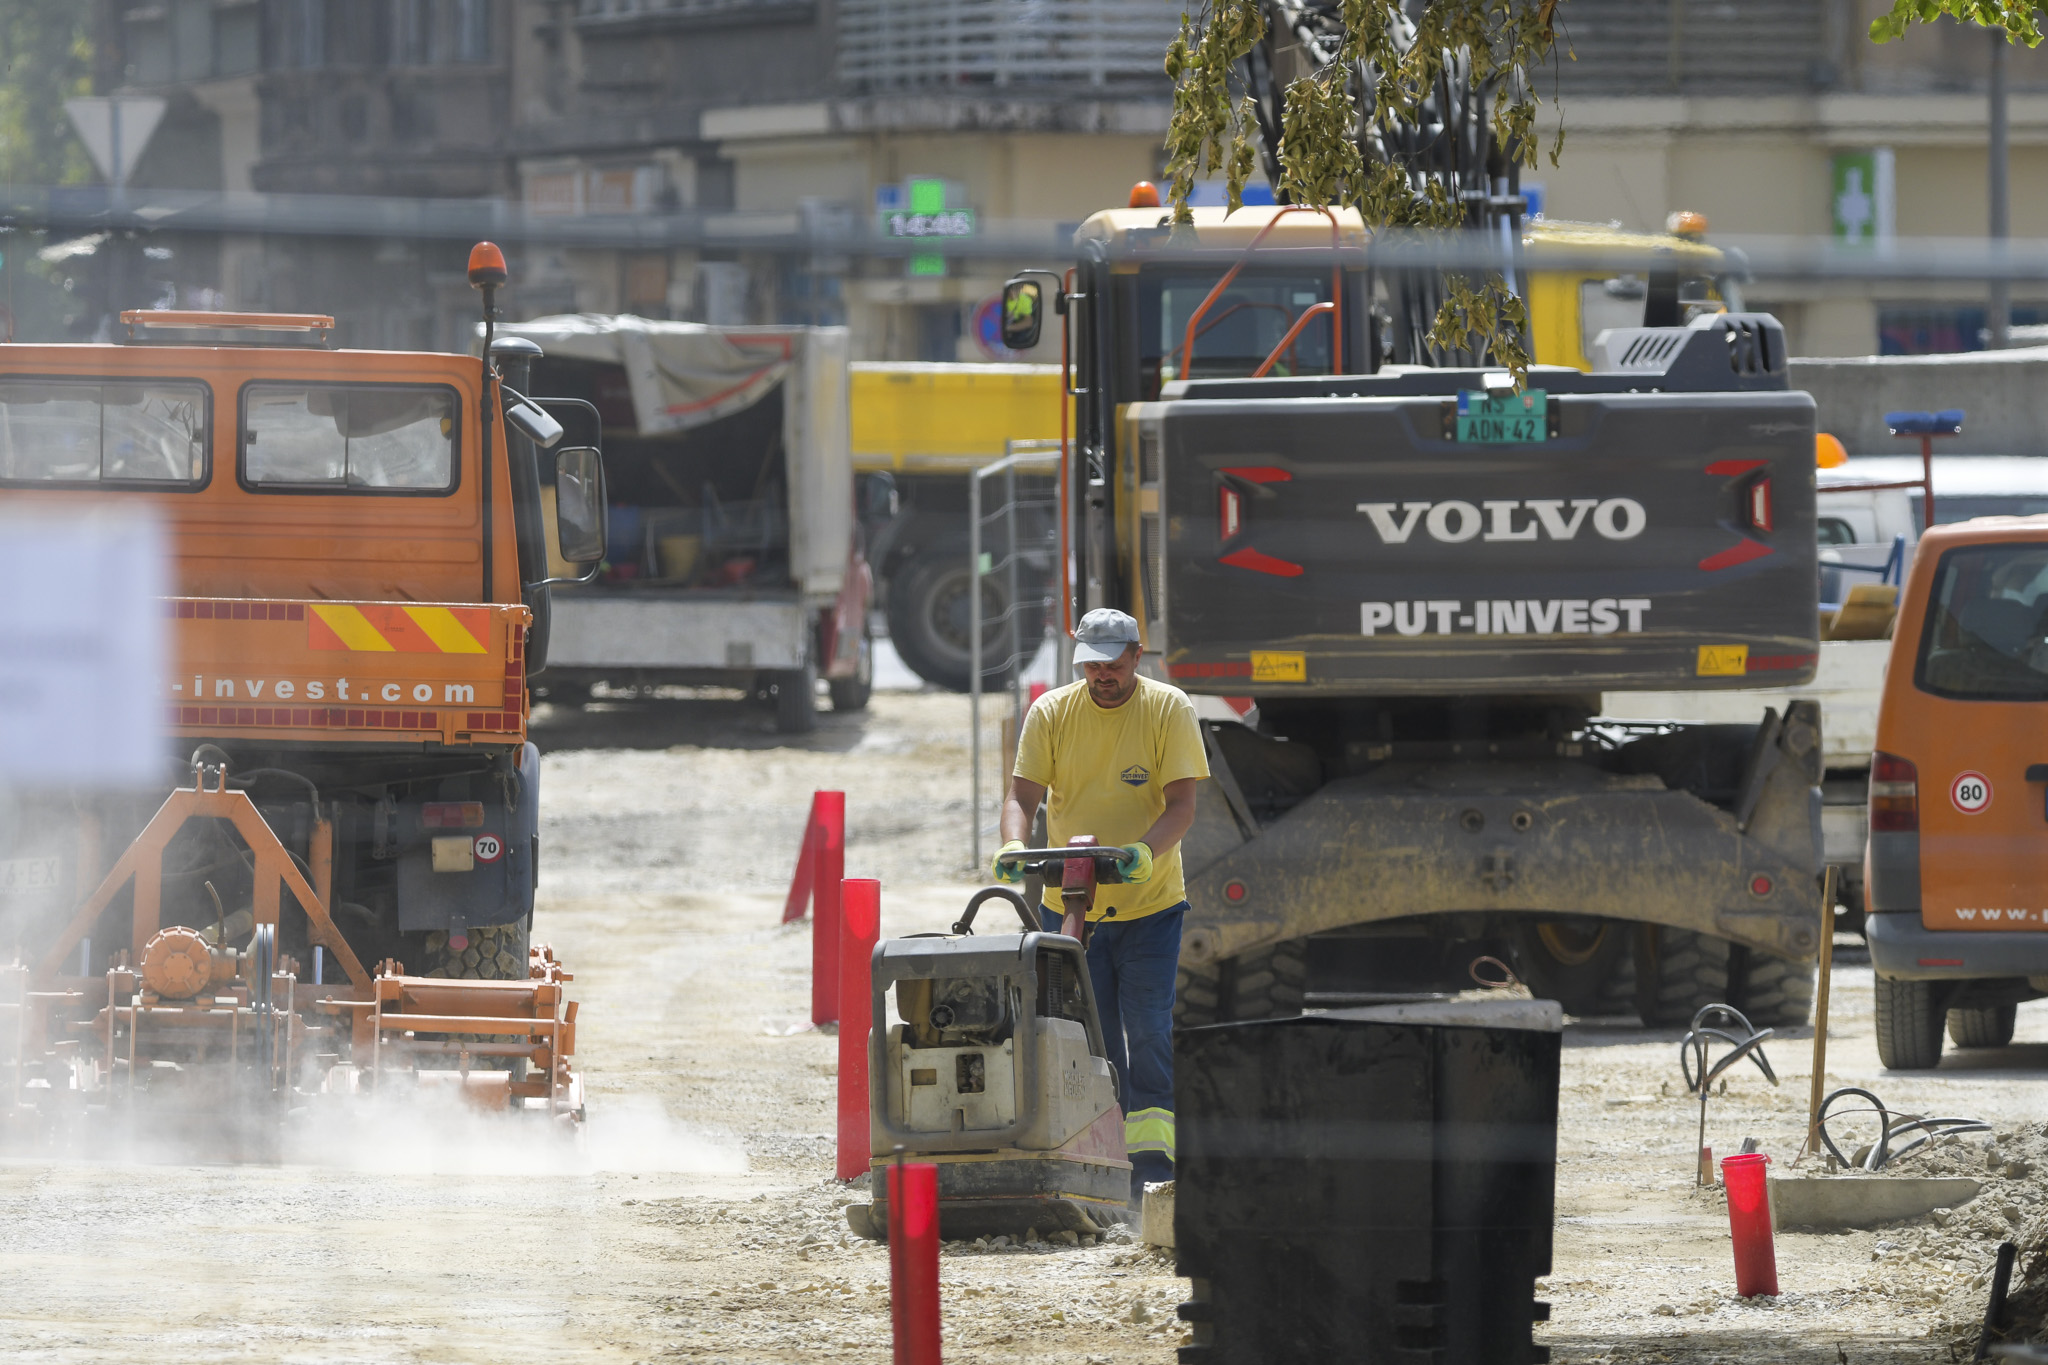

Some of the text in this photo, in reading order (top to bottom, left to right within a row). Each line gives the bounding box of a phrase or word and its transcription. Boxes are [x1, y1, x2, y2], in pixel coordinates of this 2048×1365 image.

[1356, 497, 1647, 544] VOLVO
[1360, 598, 1652, 637] PUT-INVEST
[156, 674, 475, 703] -invest.com
[1960, 784, 1982, 801] 80
[479, 842, 497, 854] 70
